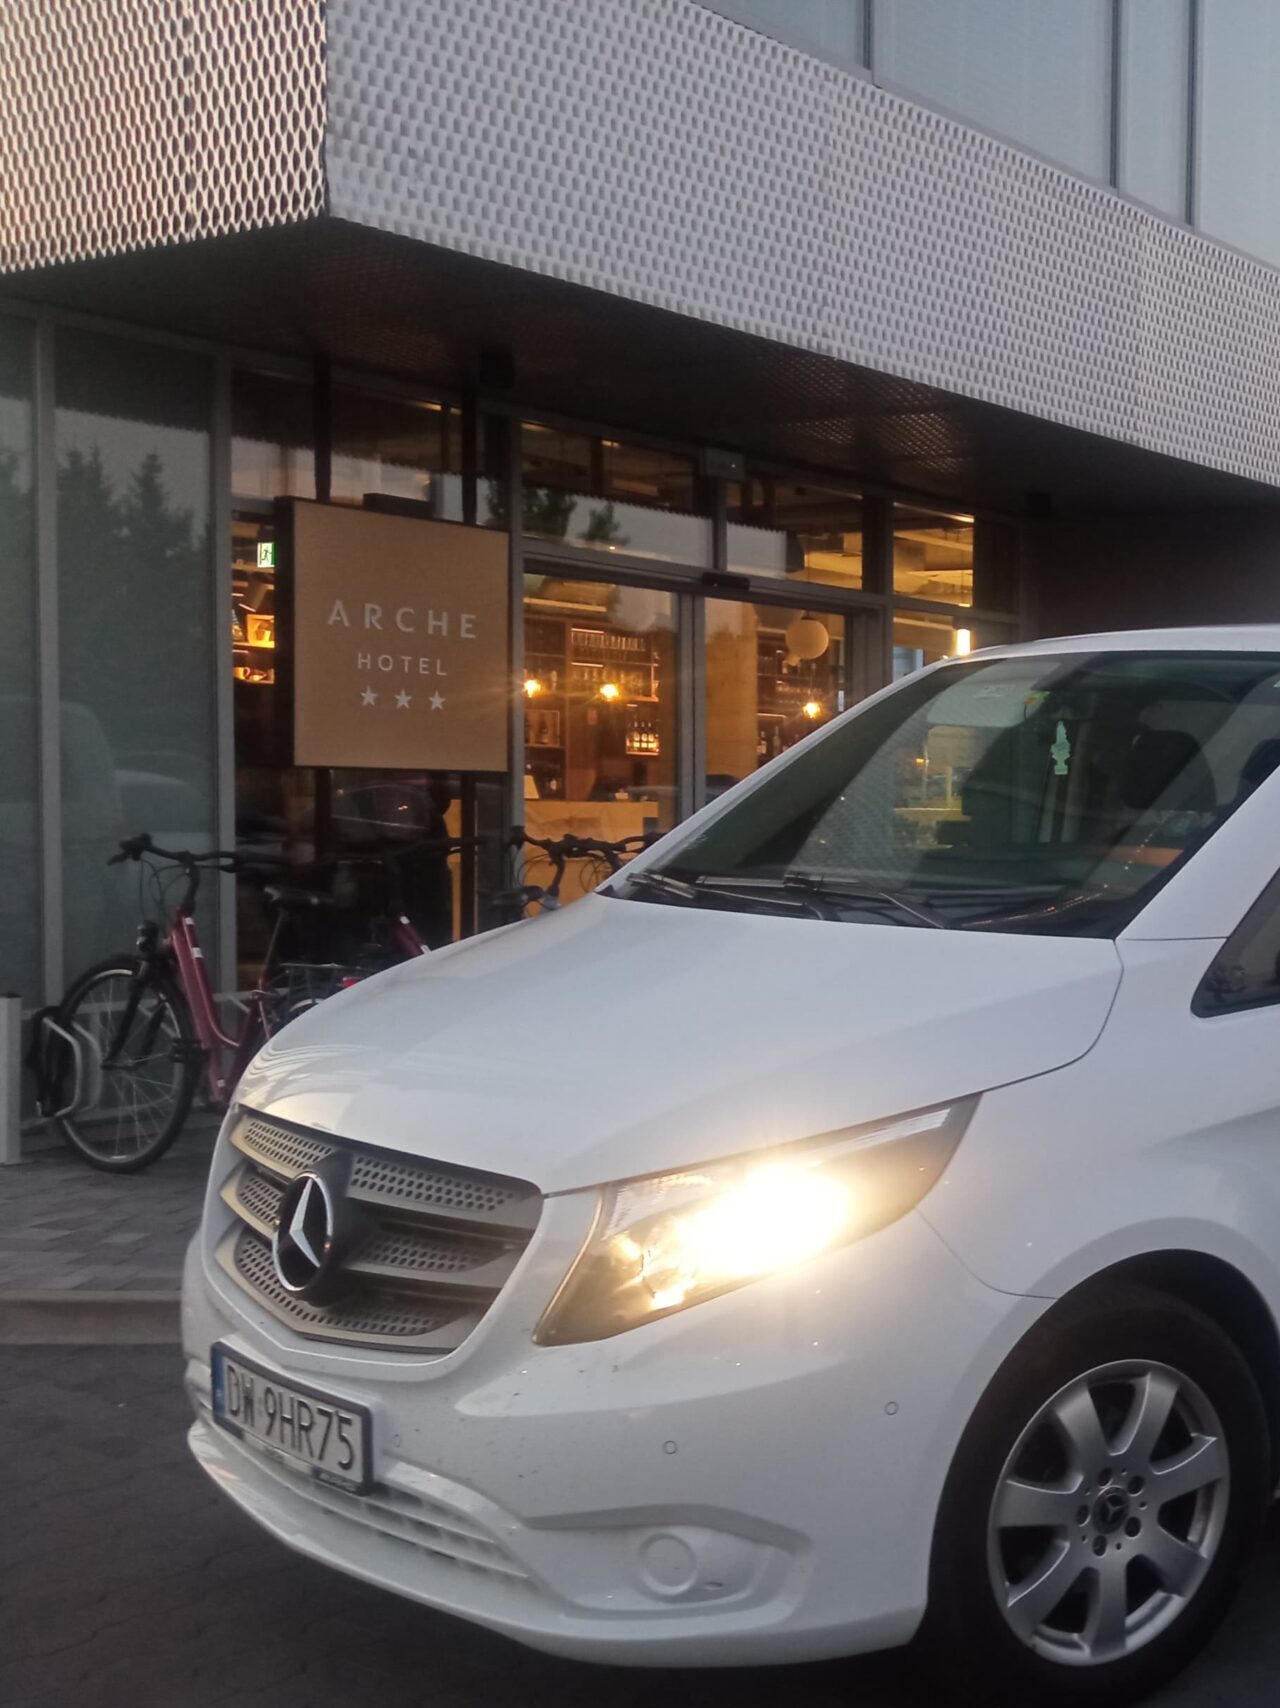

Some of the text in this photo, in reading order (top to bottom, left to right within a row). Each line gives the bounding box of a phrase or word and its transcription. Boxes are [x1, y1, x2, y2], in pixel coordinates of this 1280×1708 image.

[327, 599, 477, 639] ARCHE
[357, 652, 448, 676] HOTEL
[226, 1364, 355, 1471] DW 9HR75
